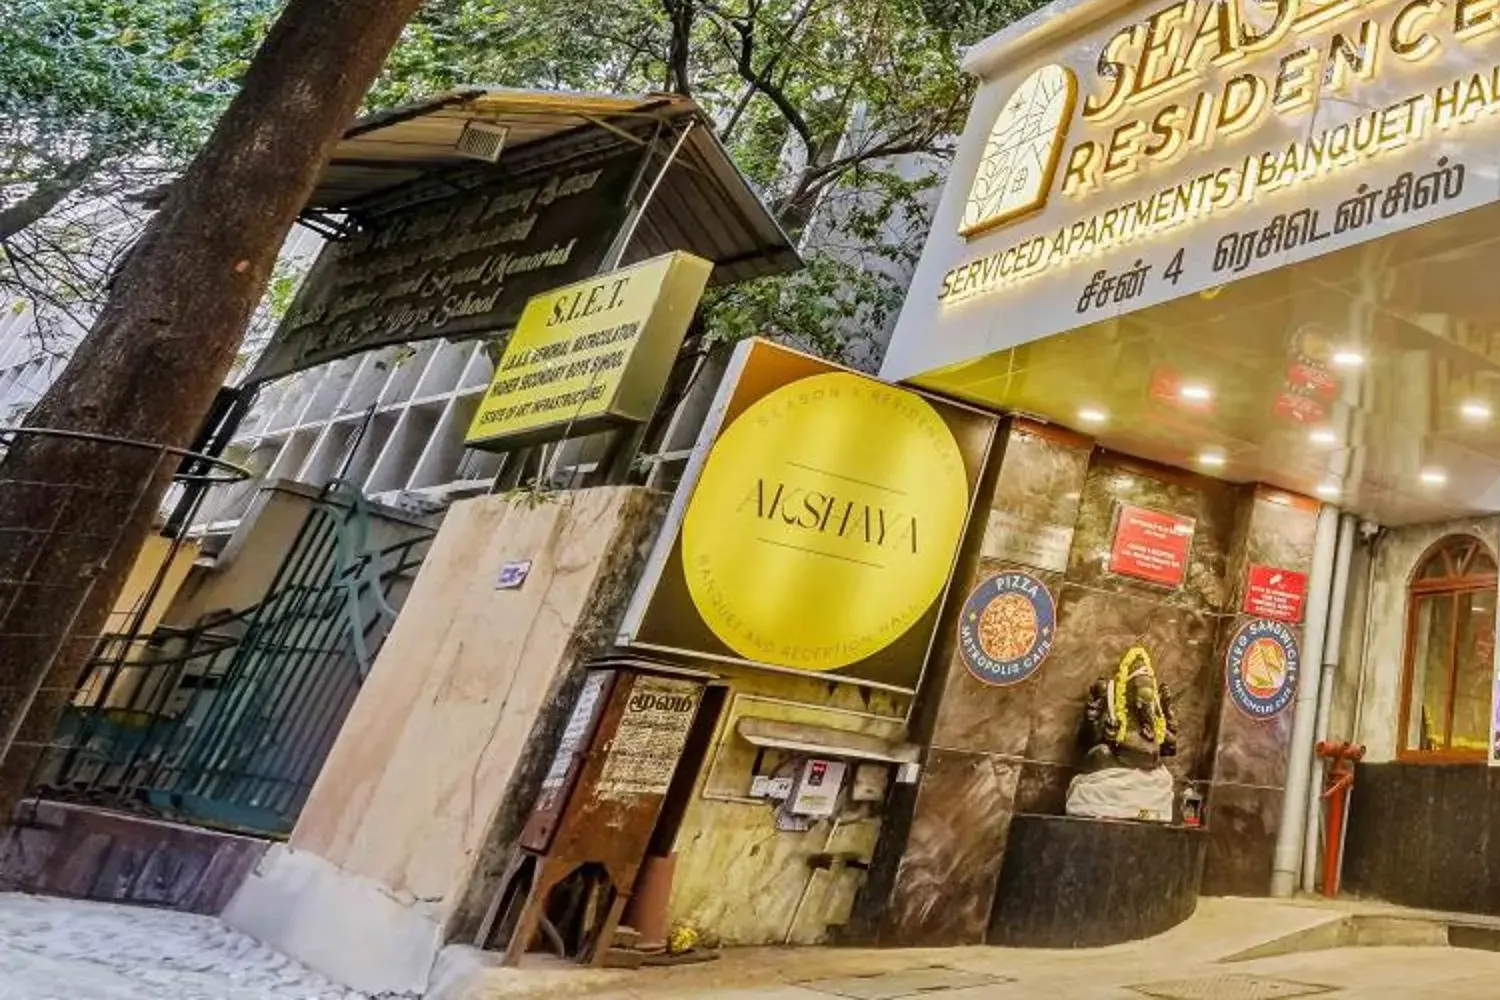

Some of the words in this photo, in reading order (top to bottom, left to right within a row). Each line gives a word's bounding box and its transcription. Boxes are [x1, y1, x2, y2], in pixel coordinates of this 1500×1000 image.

[939, 238, 1045, 300] SERVICED
[1048, 167, 1232, 264] APARTMENTS
[1257, 97, 1428, 190] BANQUET
[1162, 248, 1185, 285] 4
[737, 477, 920, 554] AKSHAYA
[996, 575, 1039, 597] PIZZA
[961, 626, 1020, 674] METROPOLIS
